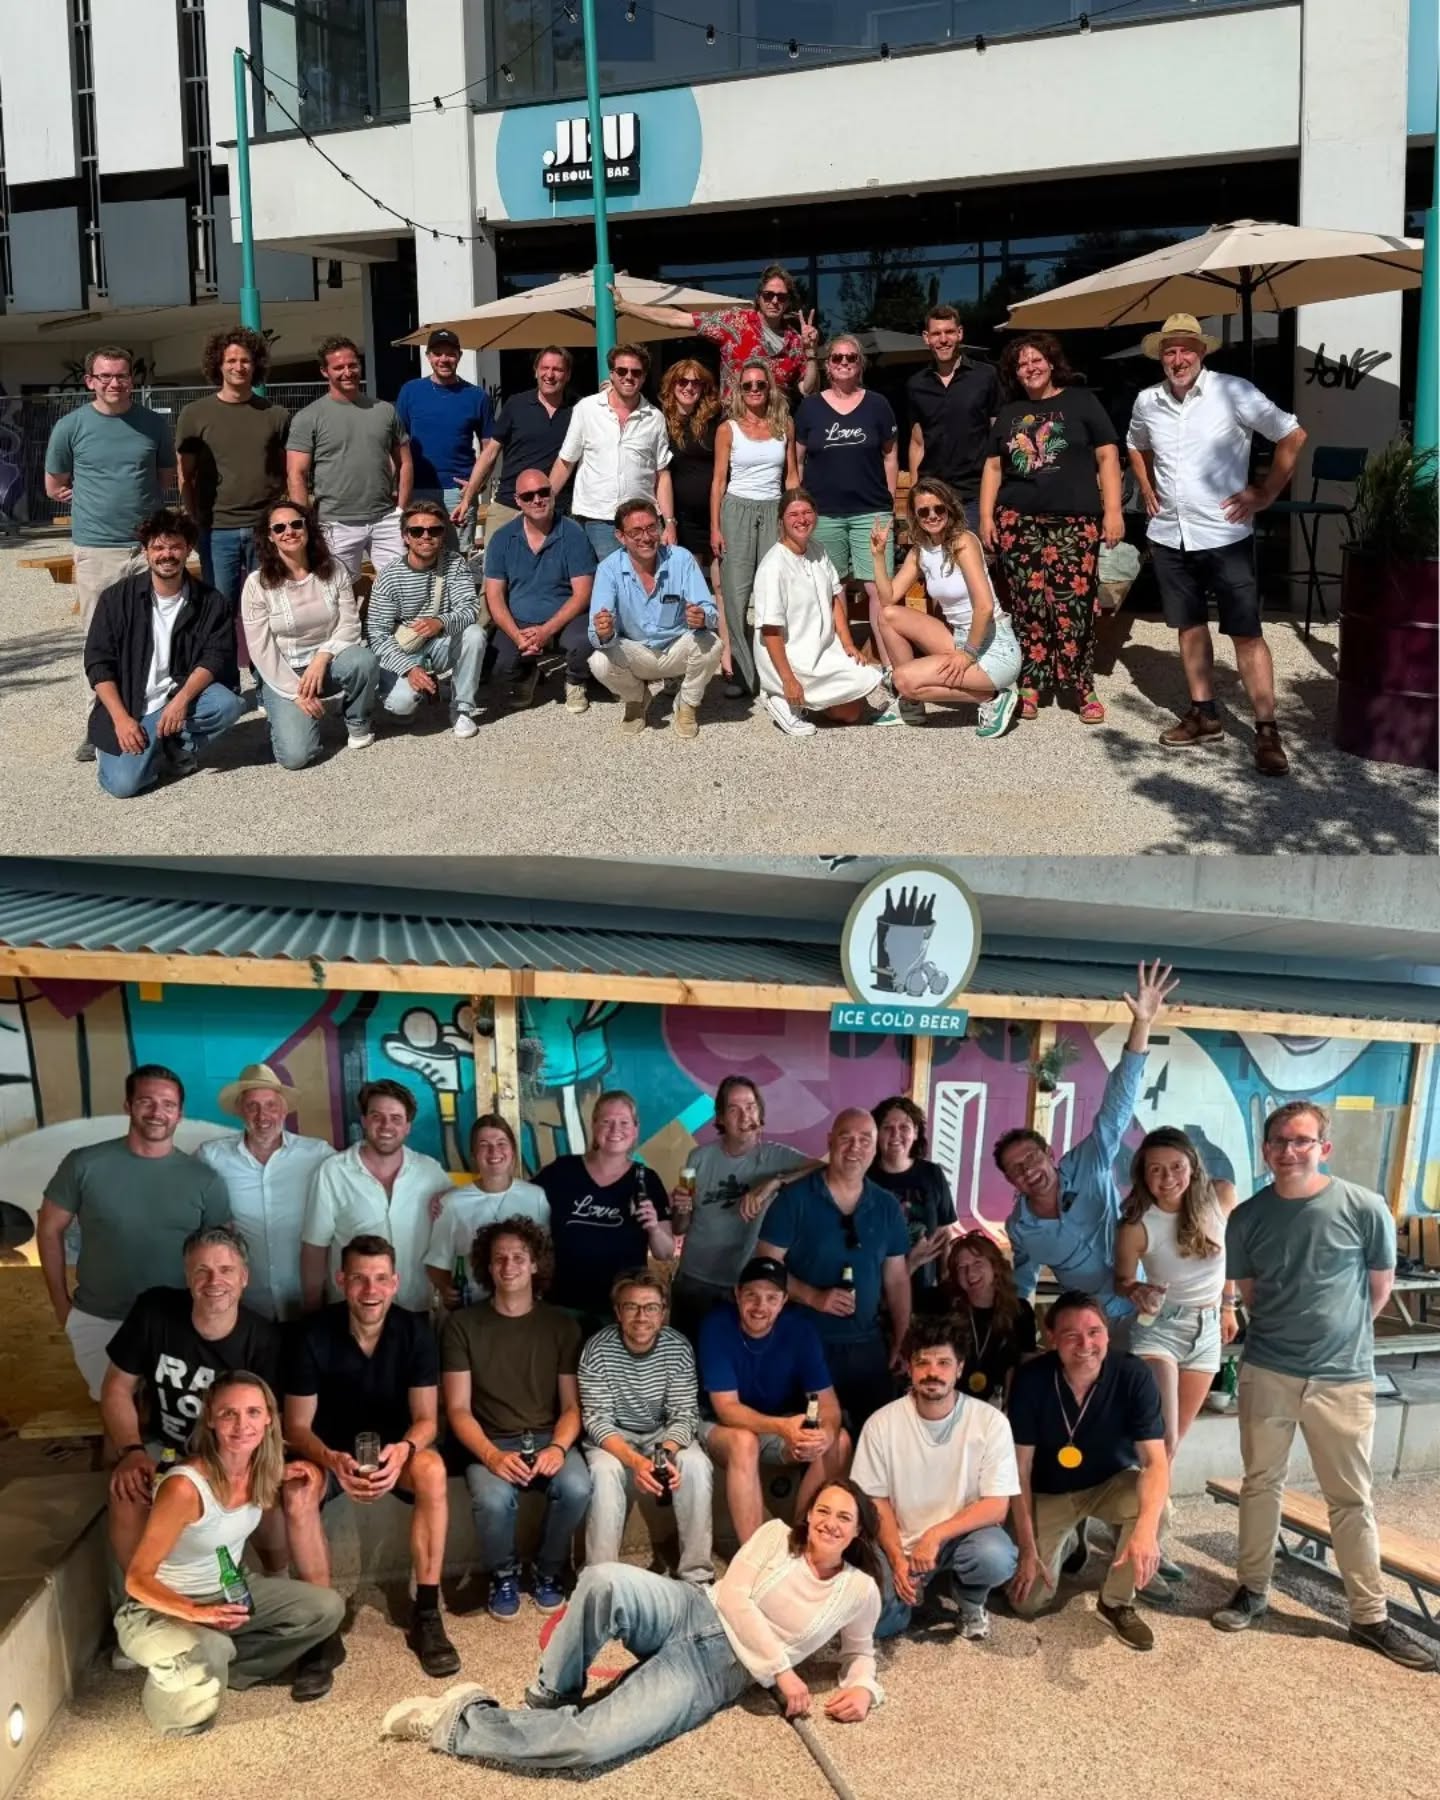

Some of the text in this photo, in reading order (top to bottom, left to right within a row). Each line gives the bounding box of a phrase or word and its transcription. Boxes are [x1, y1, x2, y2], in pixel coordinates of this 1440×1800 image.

[546, 166, 630, 184] DE BOUL BAR
[824, 422, 867, 449] Love
[838, 1009, 961, 1030] ICE COLD BEER
[567, 1194, 624, 1227] Love
